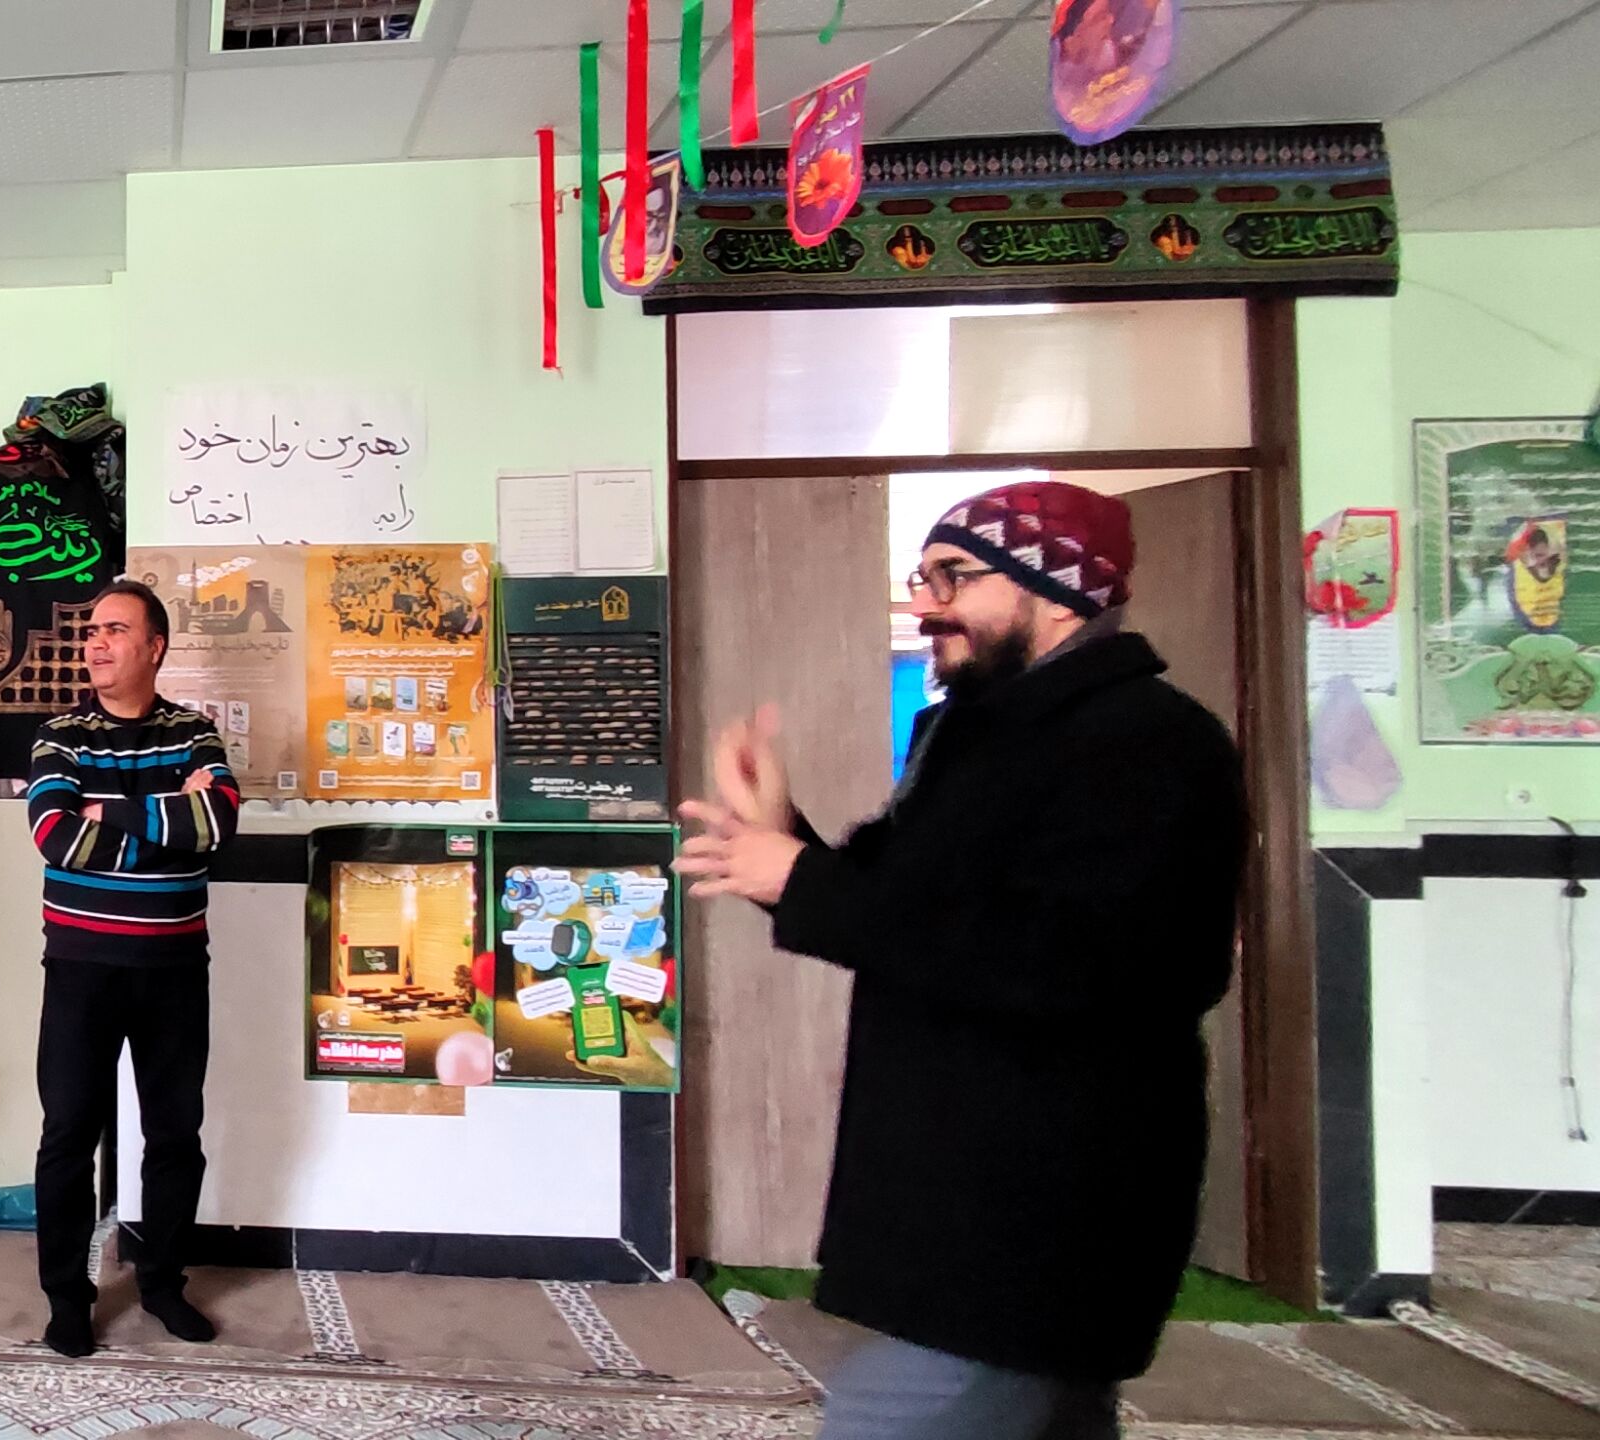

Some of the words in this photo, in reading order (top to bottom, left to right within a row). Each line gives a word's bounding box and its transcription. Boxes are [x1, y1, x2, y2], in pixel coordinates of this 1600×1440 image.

[178, 423, 241, 461] خود
[236, 414, 300, 468] زمان
[305, 422, 411, 479] بهترین
[20, 481, 61, 505] سلام
[168, 484, 252, 525] اختصاص
